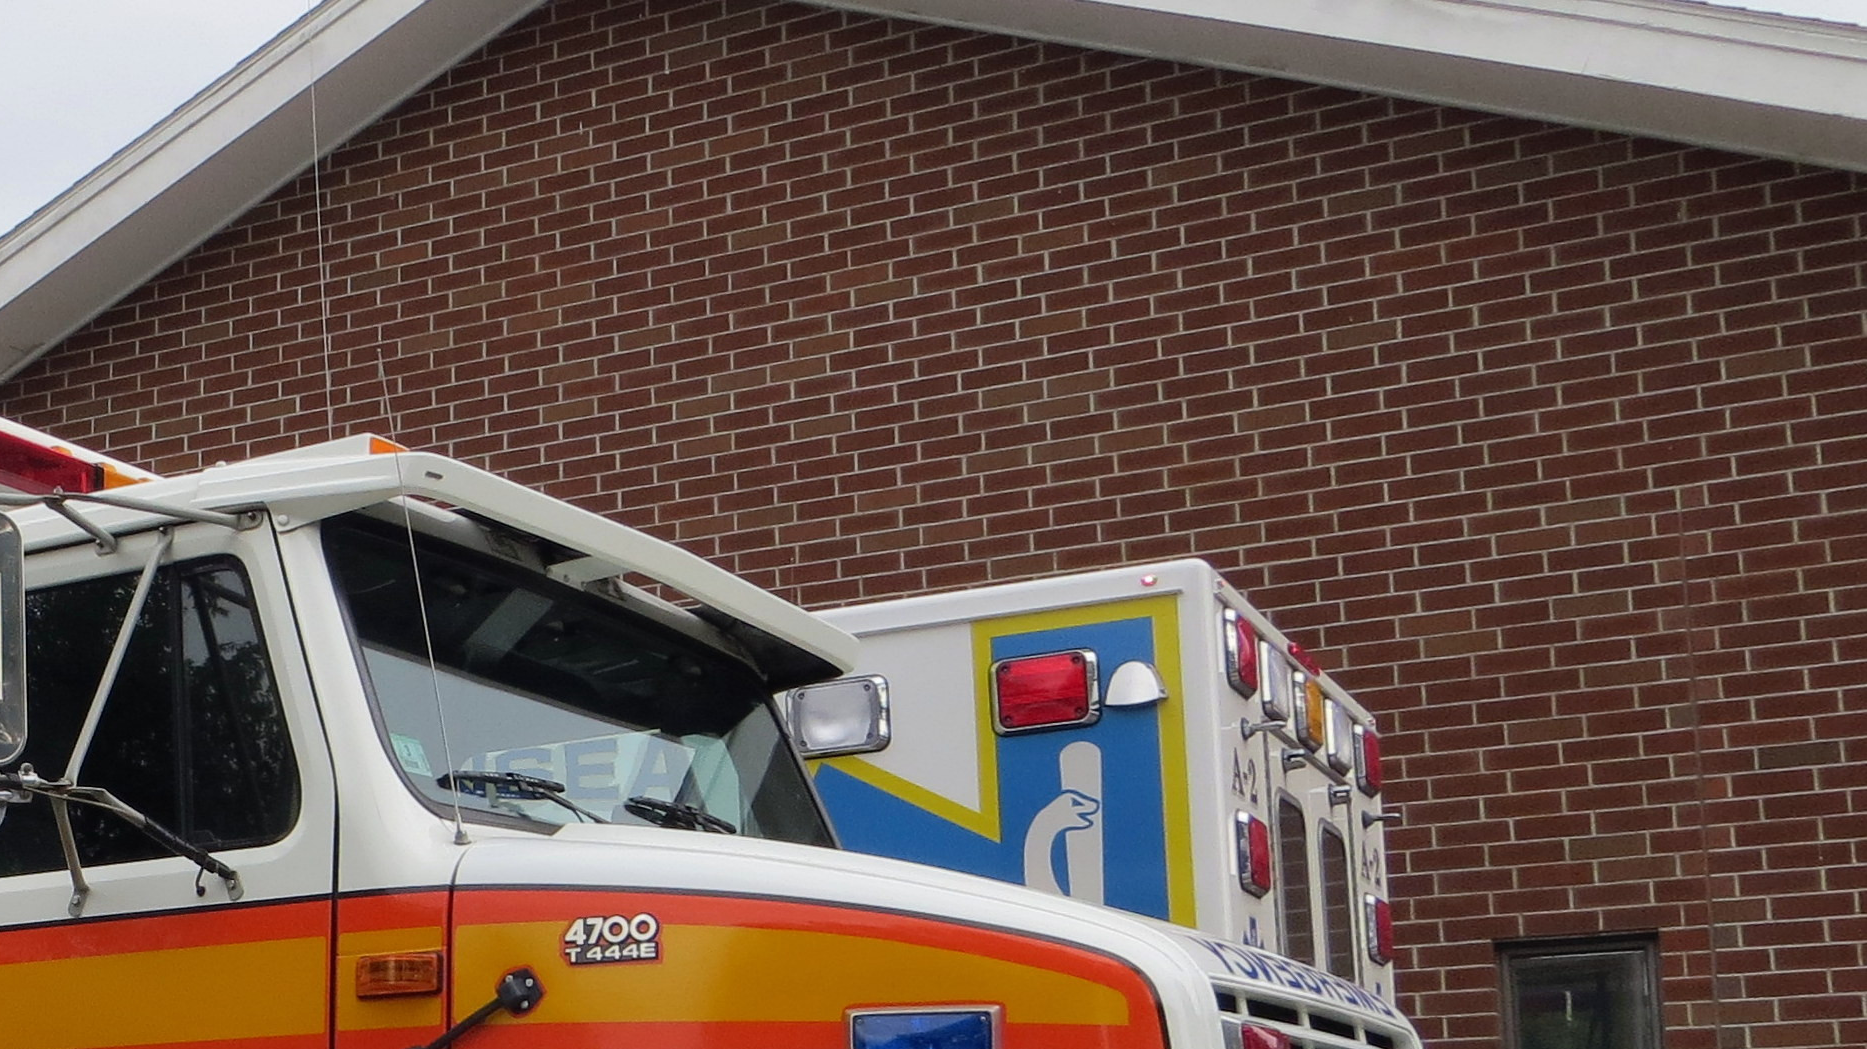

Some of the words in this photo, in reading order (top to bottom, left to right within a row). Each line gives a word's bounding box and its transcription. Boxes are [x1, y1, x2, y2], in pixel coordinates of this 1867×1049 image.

[564, 912, 659, 946] 4700
[564, 946, 582, 964] T
[586, 941, 657, 961] 444E
